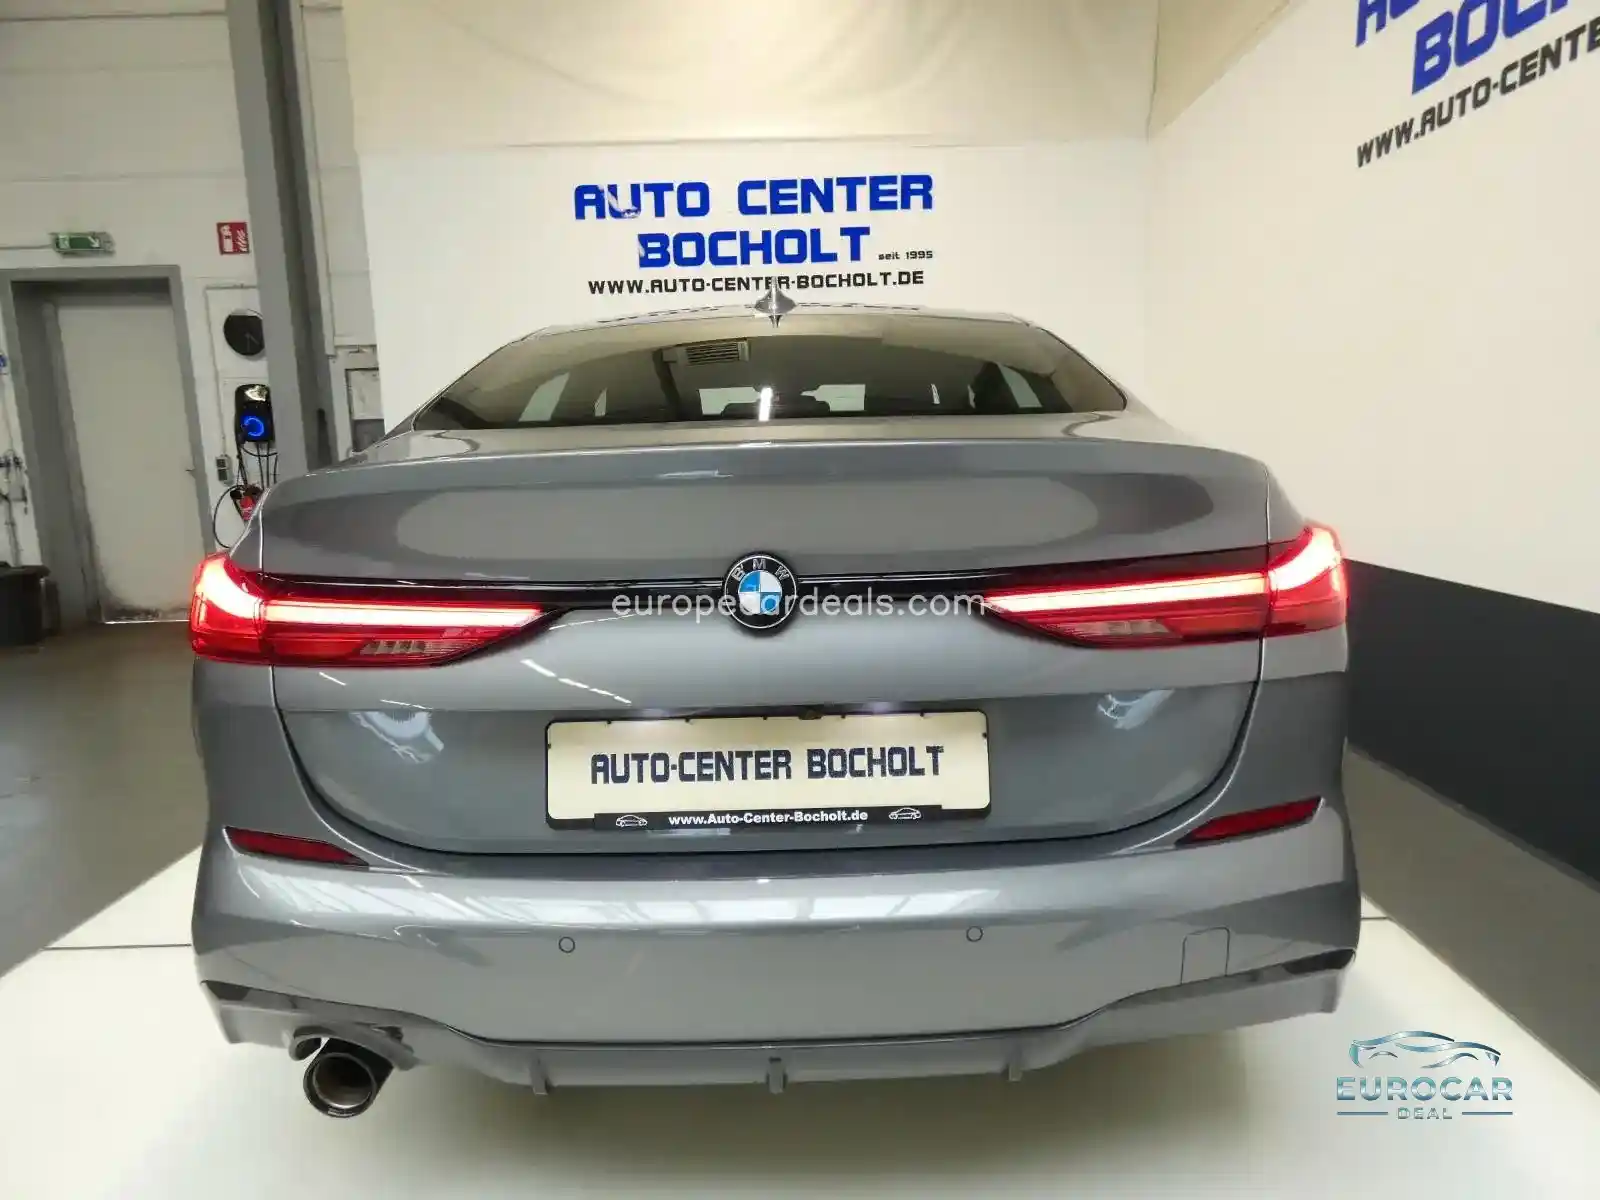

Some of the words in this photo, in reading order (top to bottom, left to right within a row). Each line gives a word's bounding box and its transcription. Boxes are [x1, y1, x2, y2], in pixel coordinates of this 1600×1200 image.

[573, 181, 710, 220] AUTO
[737, 174, 933, 216] CENTER
[637, 226, 871, 269] BOCHOLT
[878, 251, 900, 260] seit
[905, 250, 933, 260] 1995
[731, 558, 789, 582] BMW
[590, 748, 792, 784] AUTO-CENTER
[807, 745, 944, 779] BOCHOLT
[668, 810, 868, 826] www.Auto-Center-Bocholt.de
